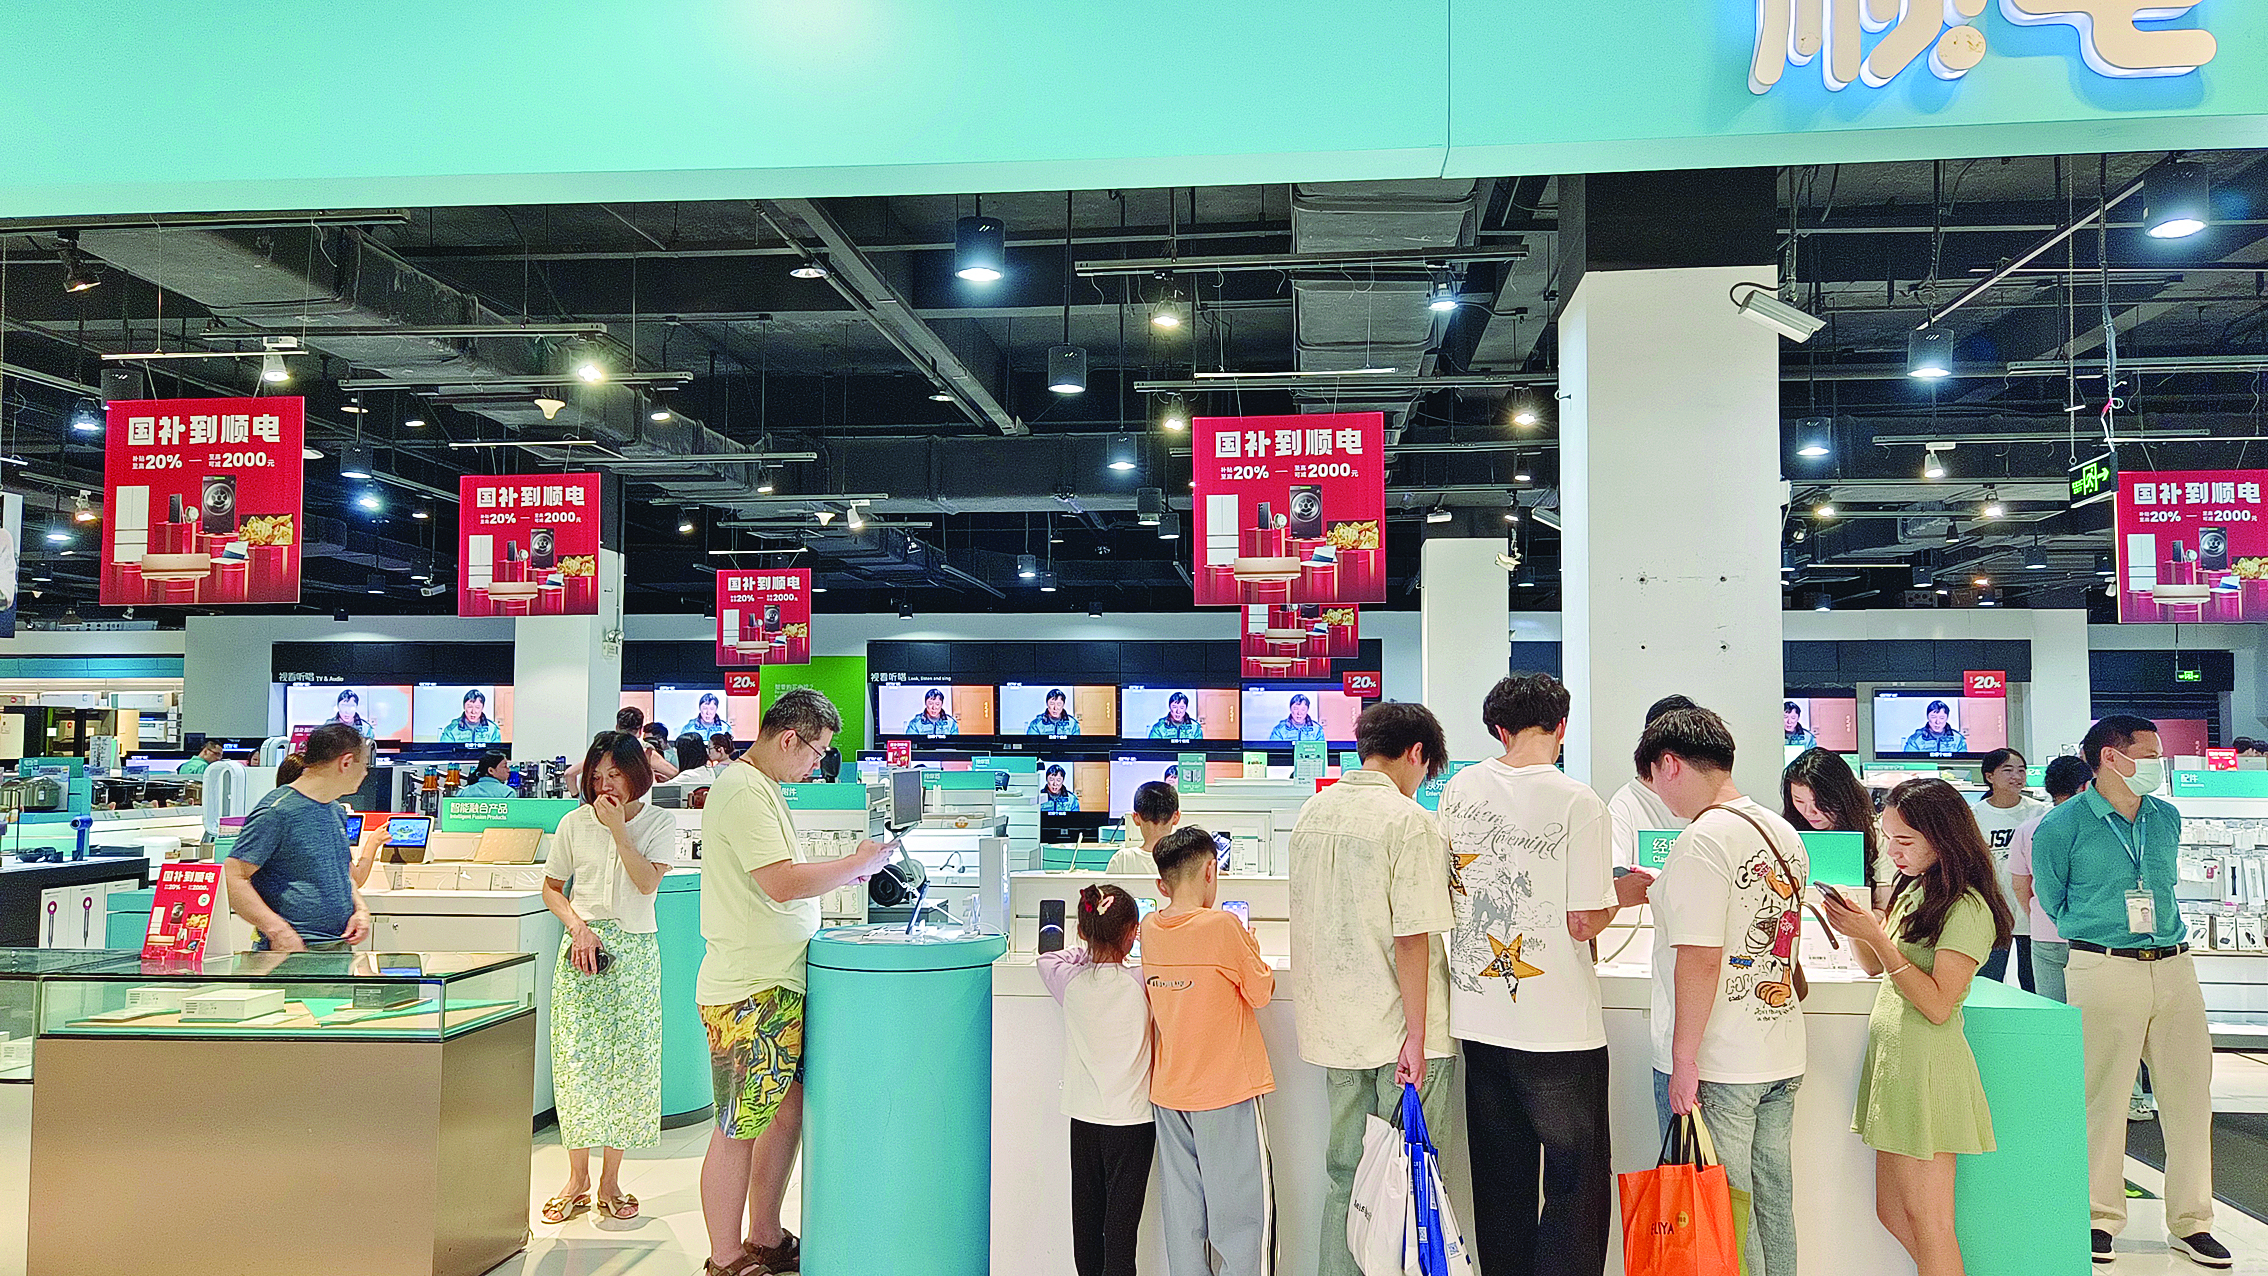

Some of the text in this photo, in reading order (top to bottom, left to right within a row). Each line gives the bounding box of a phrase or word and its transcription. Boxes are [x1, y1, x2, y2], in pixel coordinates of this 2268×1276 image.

[128, 414, 280, 445] 国补到顺电
[1215, 428, 1363, 458] 国补到顺电
[145, 454, 183, 469] 20%
[1233, 465, 1269, 480] 20%
[477, 485, 585, 507] 国补到顺电
[2134, 481, 2261, 505] 国补到顺电
[489, 513, 516, 524] 20%
[2149, 510, 2181, 522] 20%
[728, 576, 800, 591] 国补到顺电
[737, 594, 755, 602] 20%
[733, 677, 755, 688] 20%
[1352, 676, 1376, 688] 20%
[1973, 676, 2001, 689] 20%
[450, 803, 508, 814] 智能融合产品
